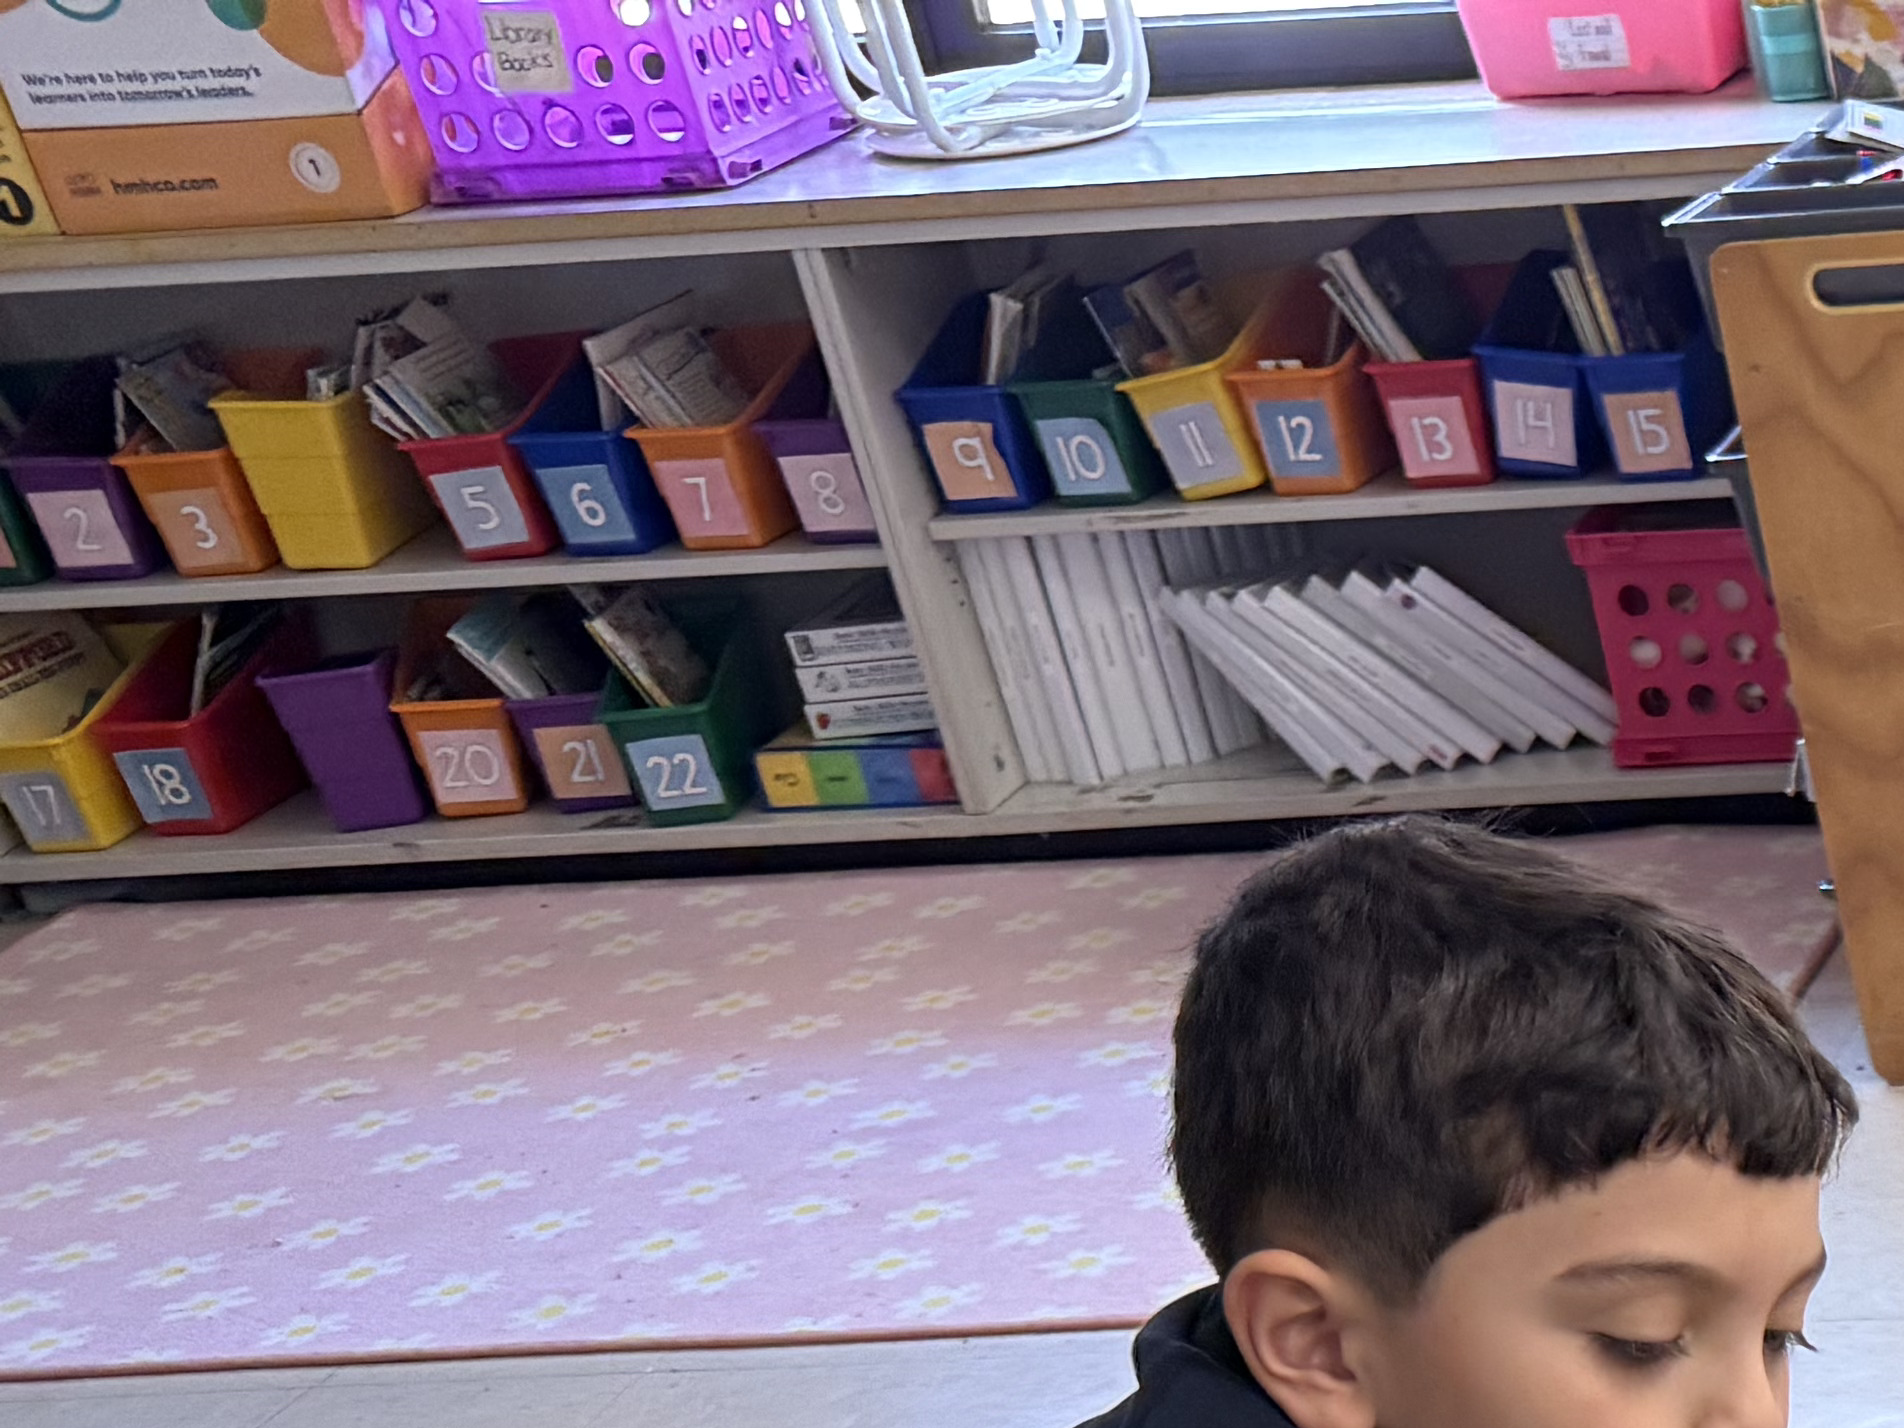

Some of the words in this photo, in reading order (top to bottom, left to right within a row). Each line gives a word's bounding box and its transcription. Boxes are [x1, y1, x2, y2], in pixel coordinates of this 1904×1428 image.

[65, 72, 97, 85] here
[99, 72, 114, 84] to
[116, 70, 148, 86] help
[150, 71, 176, 85] you
[89, 90, 117, 103] into
[1179, 420, 1214, 468] 11
[1278, 414, 1322, 462] 12
[1411, 415, 1454, 462] 13
[1515, 398, 1556, 449] 14
[1625, 407, 1671, 455] 15
[952, 436, 995, 481] 9
[1056, 434, 1106, 481] 10
[460, 484, 500, 530] 5
[570, 482, 606, 527] 6
[682, 477, 712, 522] 7
[808, 470, 846, 515] 8
[64, 507, 102, 550] 2
[180, 505, 218, 549] 3
[434, 744, 500, 788] 20
[562, 738, 605, 783] 21
[646, 752, 708, 798] 22
[22, 785, 62, 826] 17
[141, 763, 192, 805] 18
